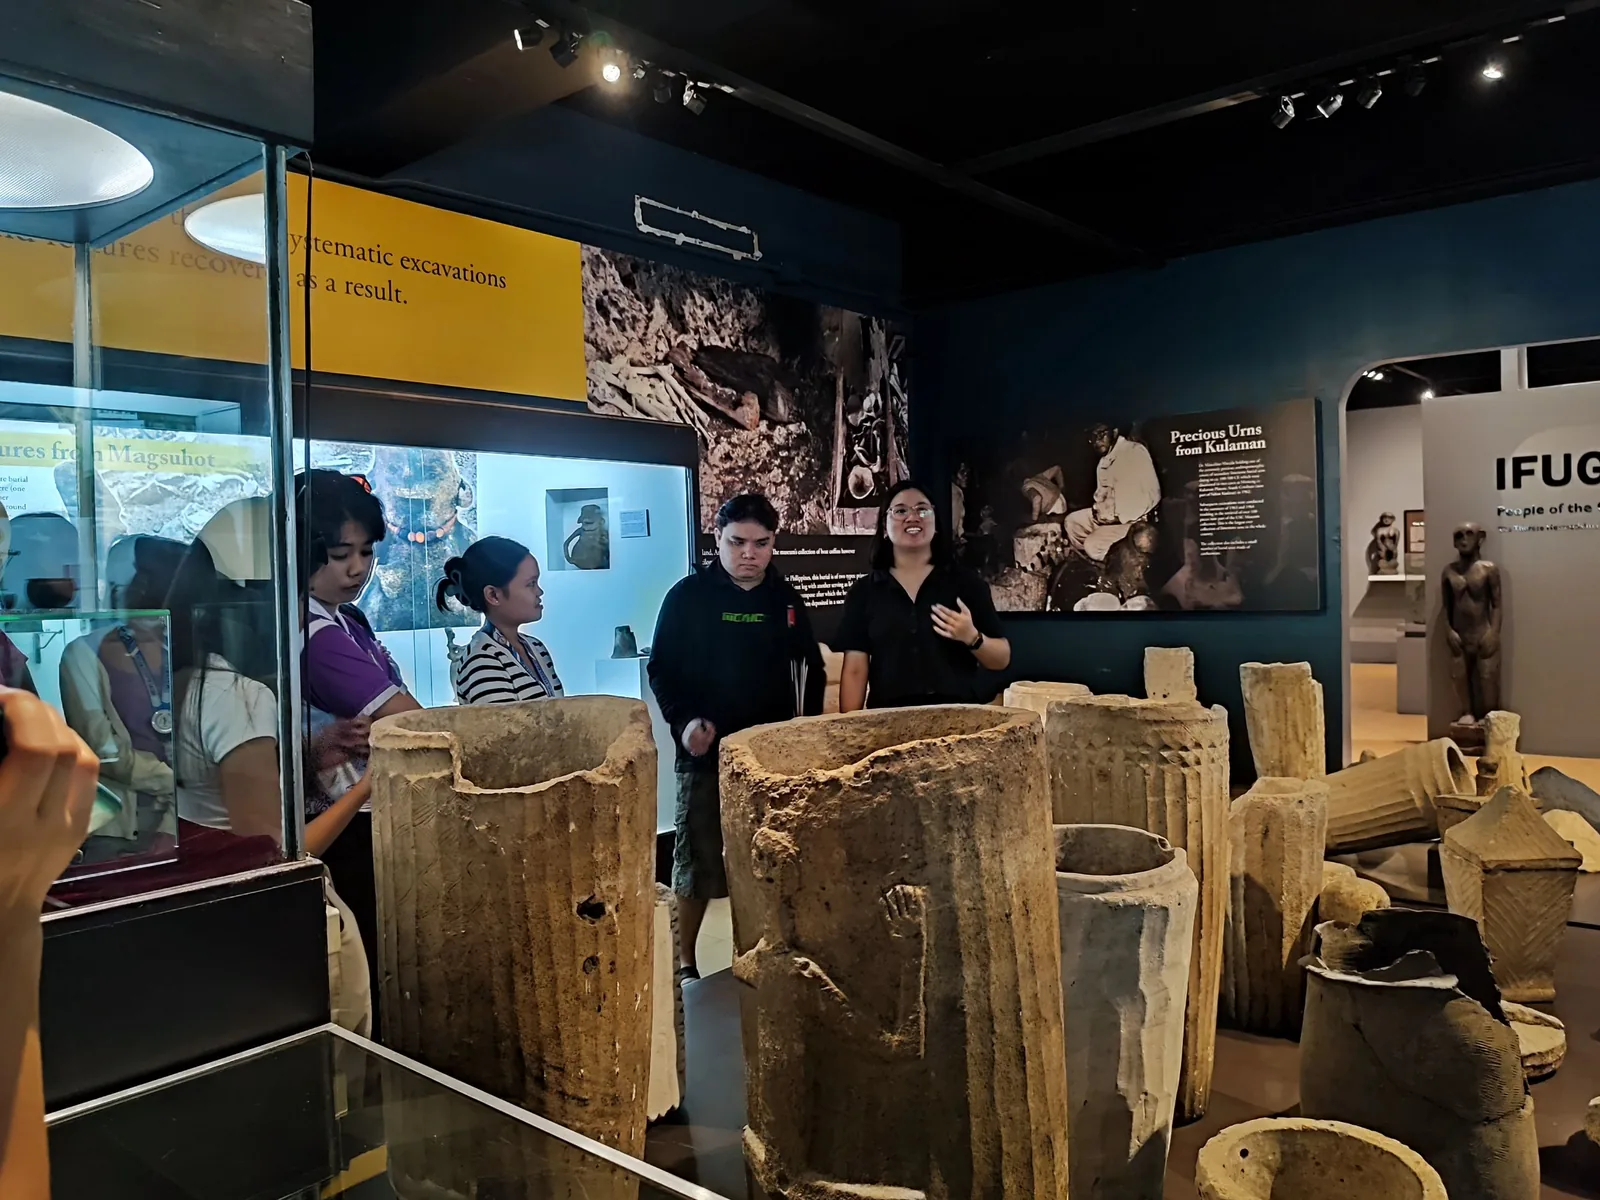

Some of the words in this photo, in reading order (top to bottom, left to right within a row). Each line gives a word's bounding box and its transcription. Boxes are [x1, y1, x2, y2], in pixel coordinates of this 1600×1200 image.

[288, 231, 394, 266] ystematic
[400, 255, 507, 289] excavations
[169, 249, 267, 280] recover
[296, 272, 318, 290] as
[325, 276, 337, 293] a
[344, 279, 408, 305] result.
[1170, 428, 1226, 444] Precious
[1228, 424, 1262, 438] Urns
[0, 445, 46, 459] ures
[107, 444, 216, 470] Magsuhot
[1175, 444, 1202, 457] from
[1204, 438, 1267, 454] Kulaman
[1496, 451, 1600, 490] IFUG
[1496, 505, 1544, 518] People
[1550, 503, 1564, 514] of
[1568, 502, 1592, 514] the
